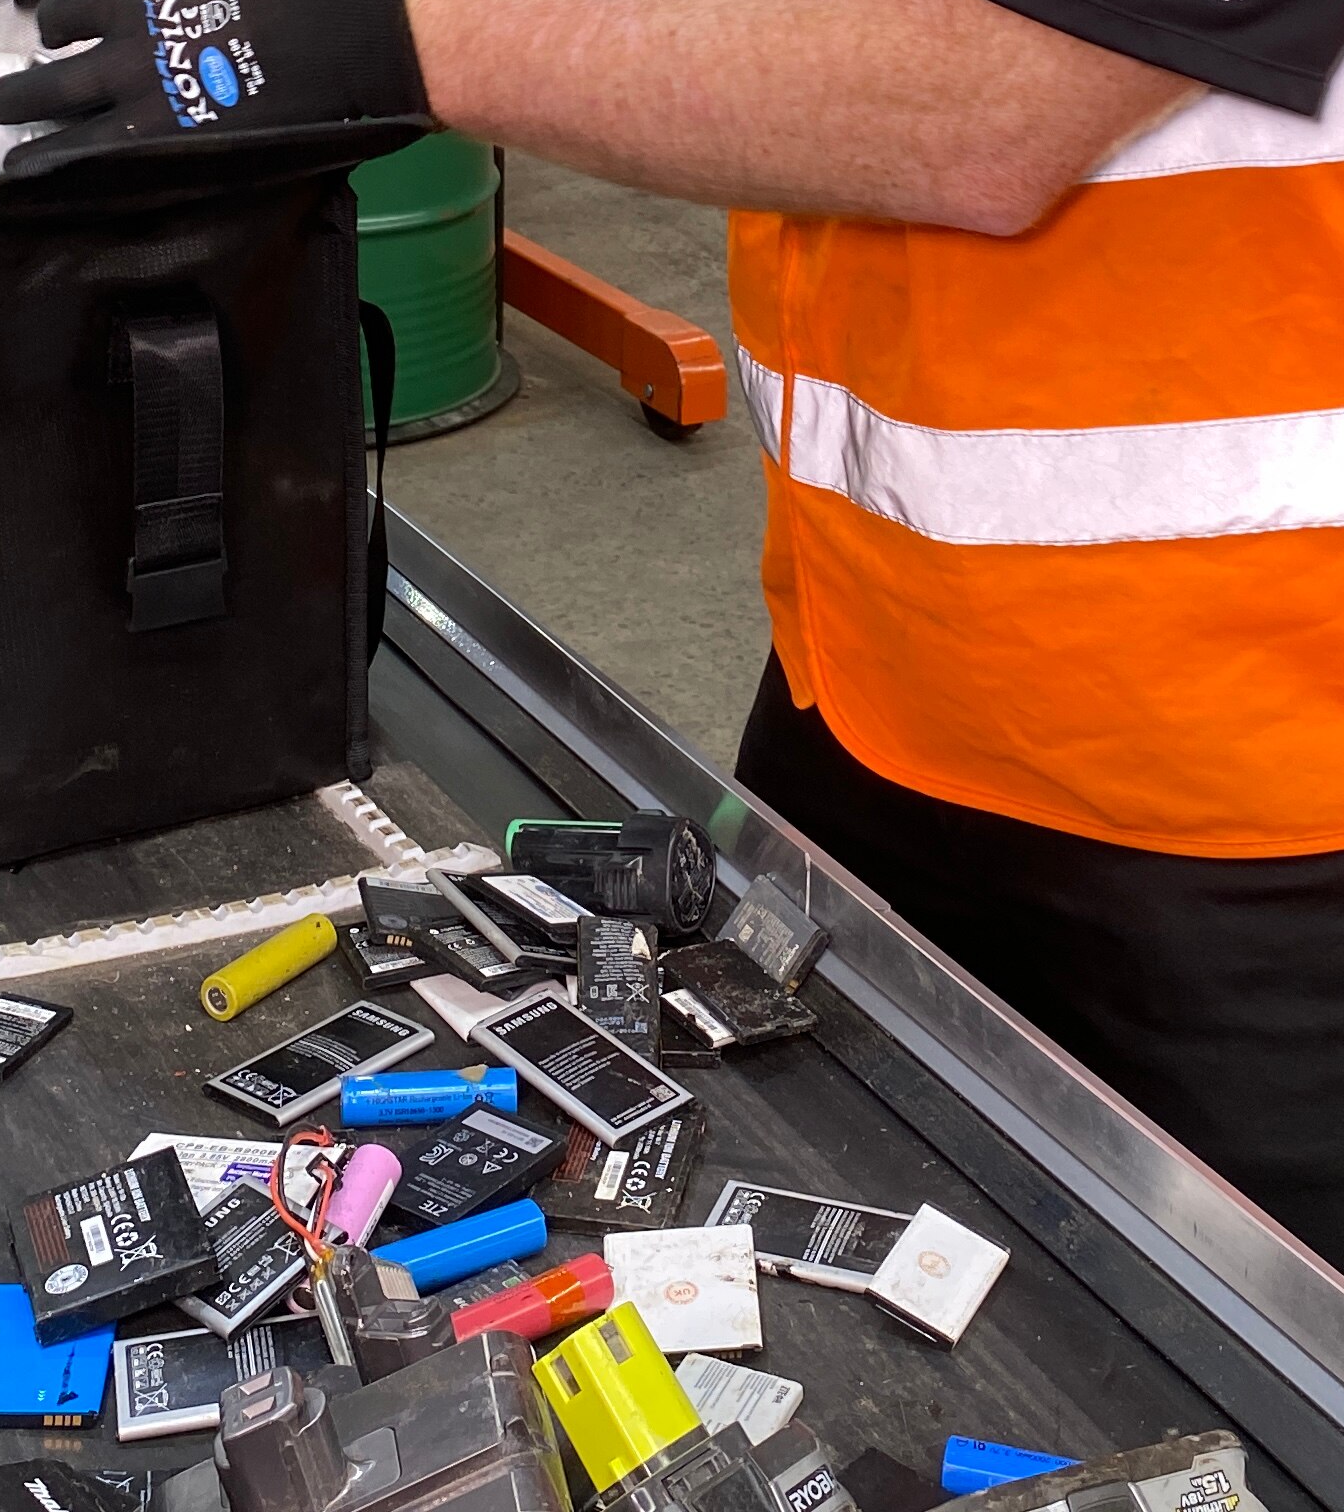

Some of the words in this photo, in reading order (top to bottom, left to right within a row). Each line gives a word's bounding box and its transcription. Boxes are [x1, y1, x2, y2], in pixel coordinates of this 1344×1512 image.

[351, 1008, 411, 1037] SAMSUNG
[494, 1002, 558, 1037] SAMSUNG
[418, 1199, 449, 1217] ZTE
[788, 1470, 835, 1512] RYOBI
